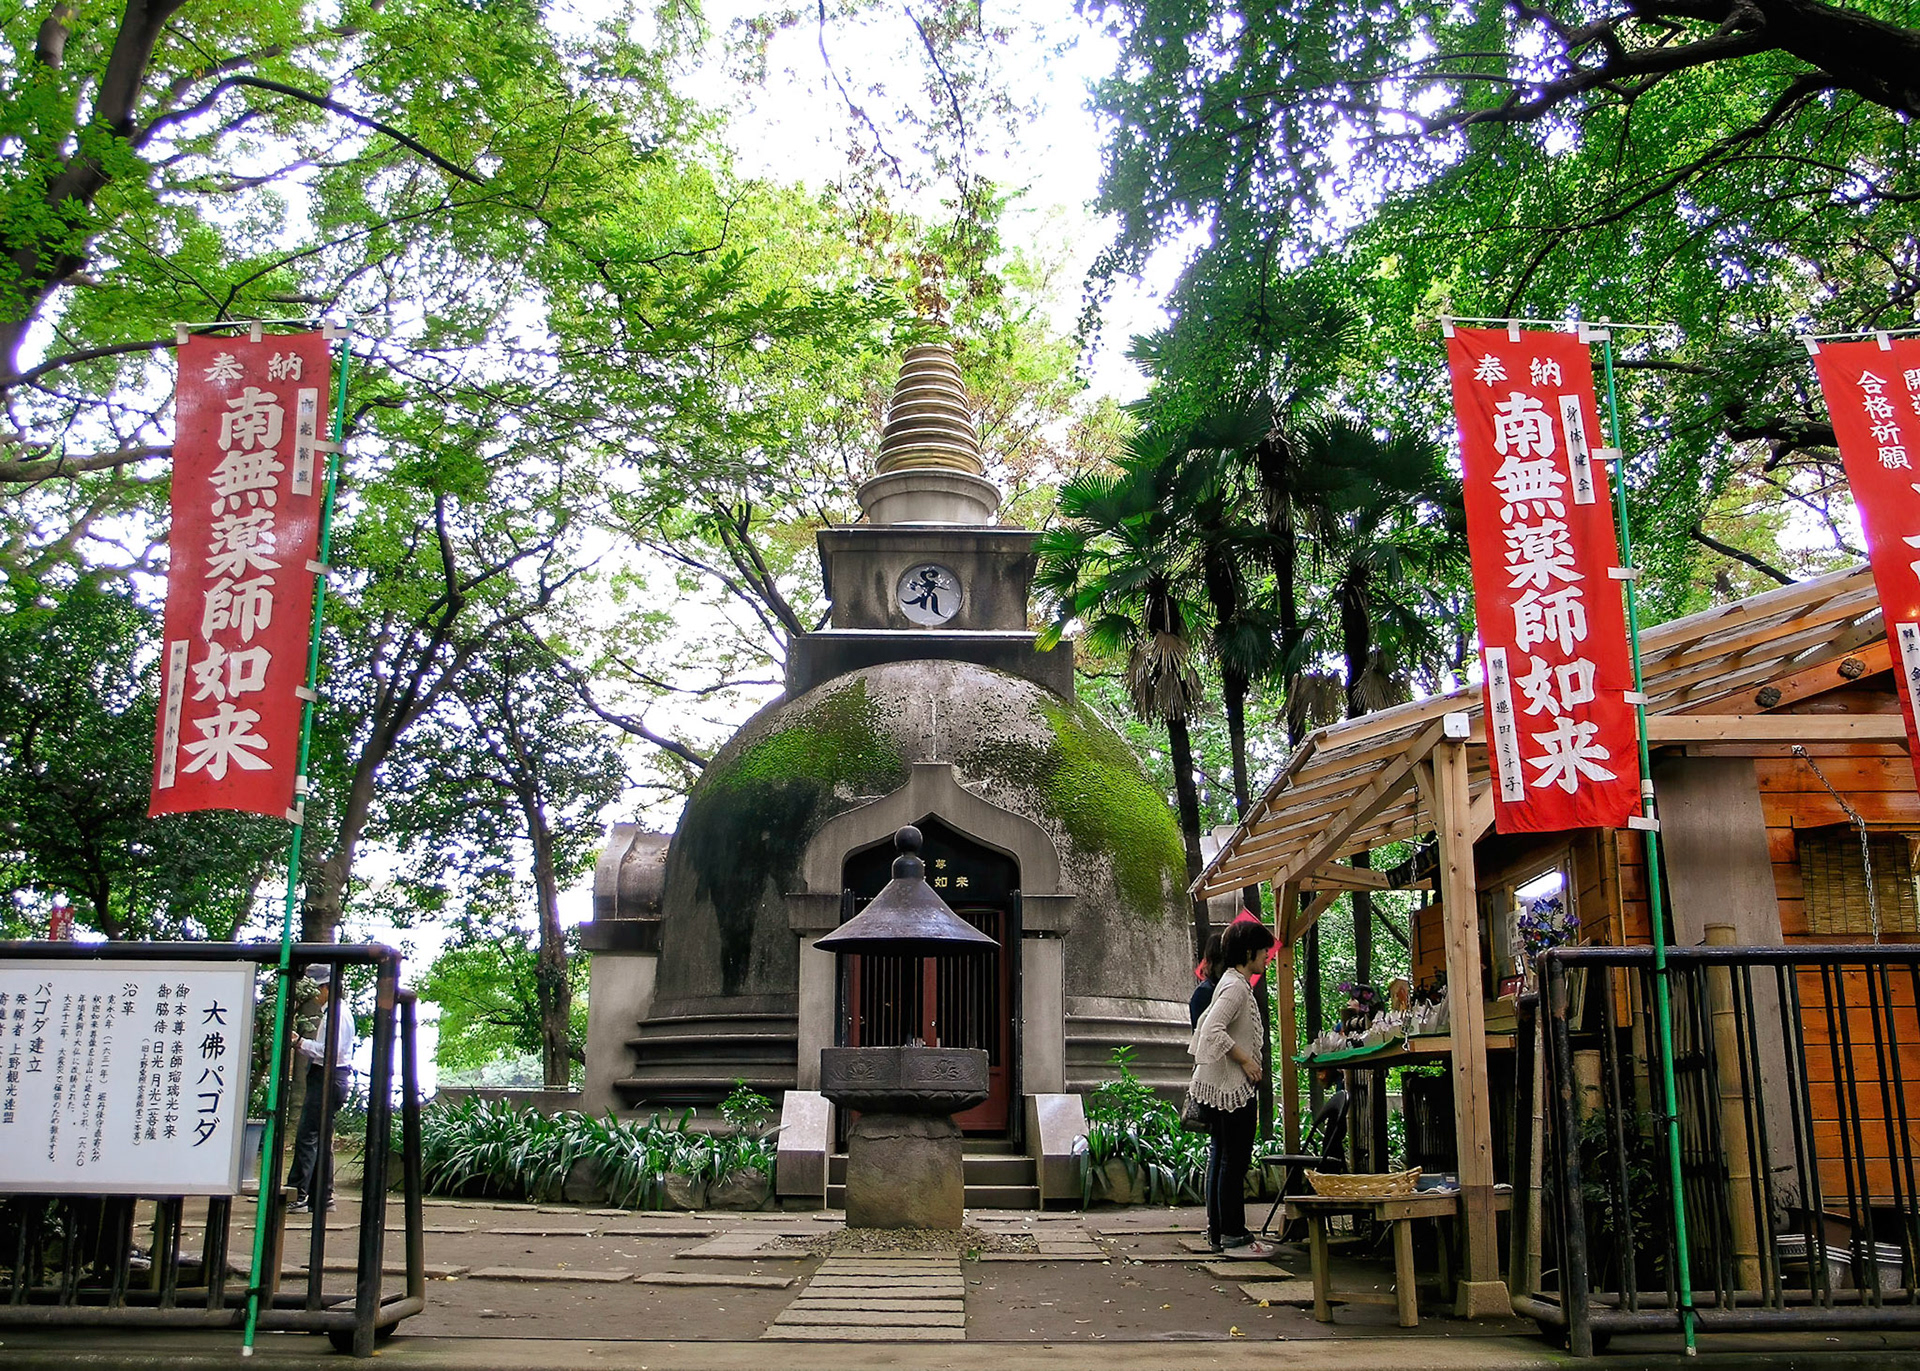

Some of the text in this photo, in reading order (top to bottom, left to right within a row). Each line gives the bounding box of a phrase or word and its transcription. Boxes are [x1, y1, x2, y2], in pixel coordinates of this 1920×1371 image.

[204, 351, 304, 386] 奉納
[1474, 352, 1563, 388] 奉納
[1566, 405, 1590, 492] 身体健全
[1857, 370, 1913, 470] 合格祈願
[182, 387, 285, 781] 南無薬師如来
[1492, 392, 1617, 795] 南無薬師如来
[26, 982, 52, 1074] パゴダ建立
[120, 982, 139, 1016] 沿革
[153, 983, 172, 1035] 御脇侍
[2, 993, 28, 1124] 発願者 上野観光連盟
[163, 983, 191, 1138] 御本尊 薬師瑠璃光如来
[192, 999, 228, 1147] 大佛パゴダ
